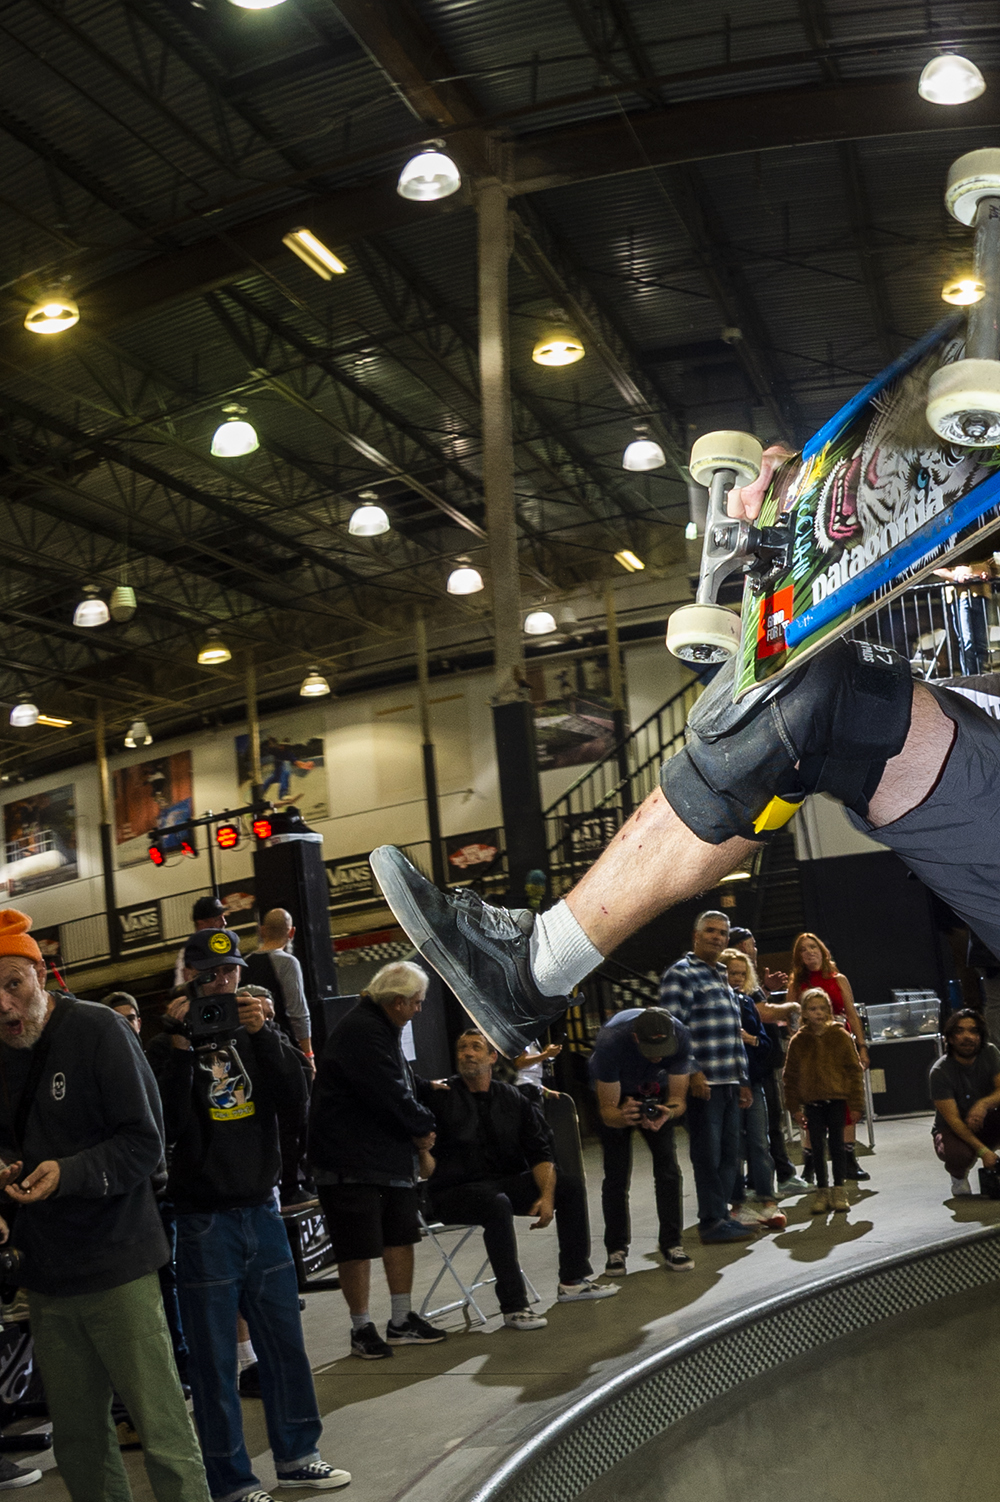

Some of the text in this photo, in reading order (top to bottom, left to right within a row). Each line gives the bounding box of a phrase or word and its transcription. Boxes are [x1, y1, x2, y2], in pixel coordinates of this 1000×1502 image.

[812, 487, 945, 606] patagonia
[326, 860, 370, 886] VANS
[118, 907, 158, 932] VANS
